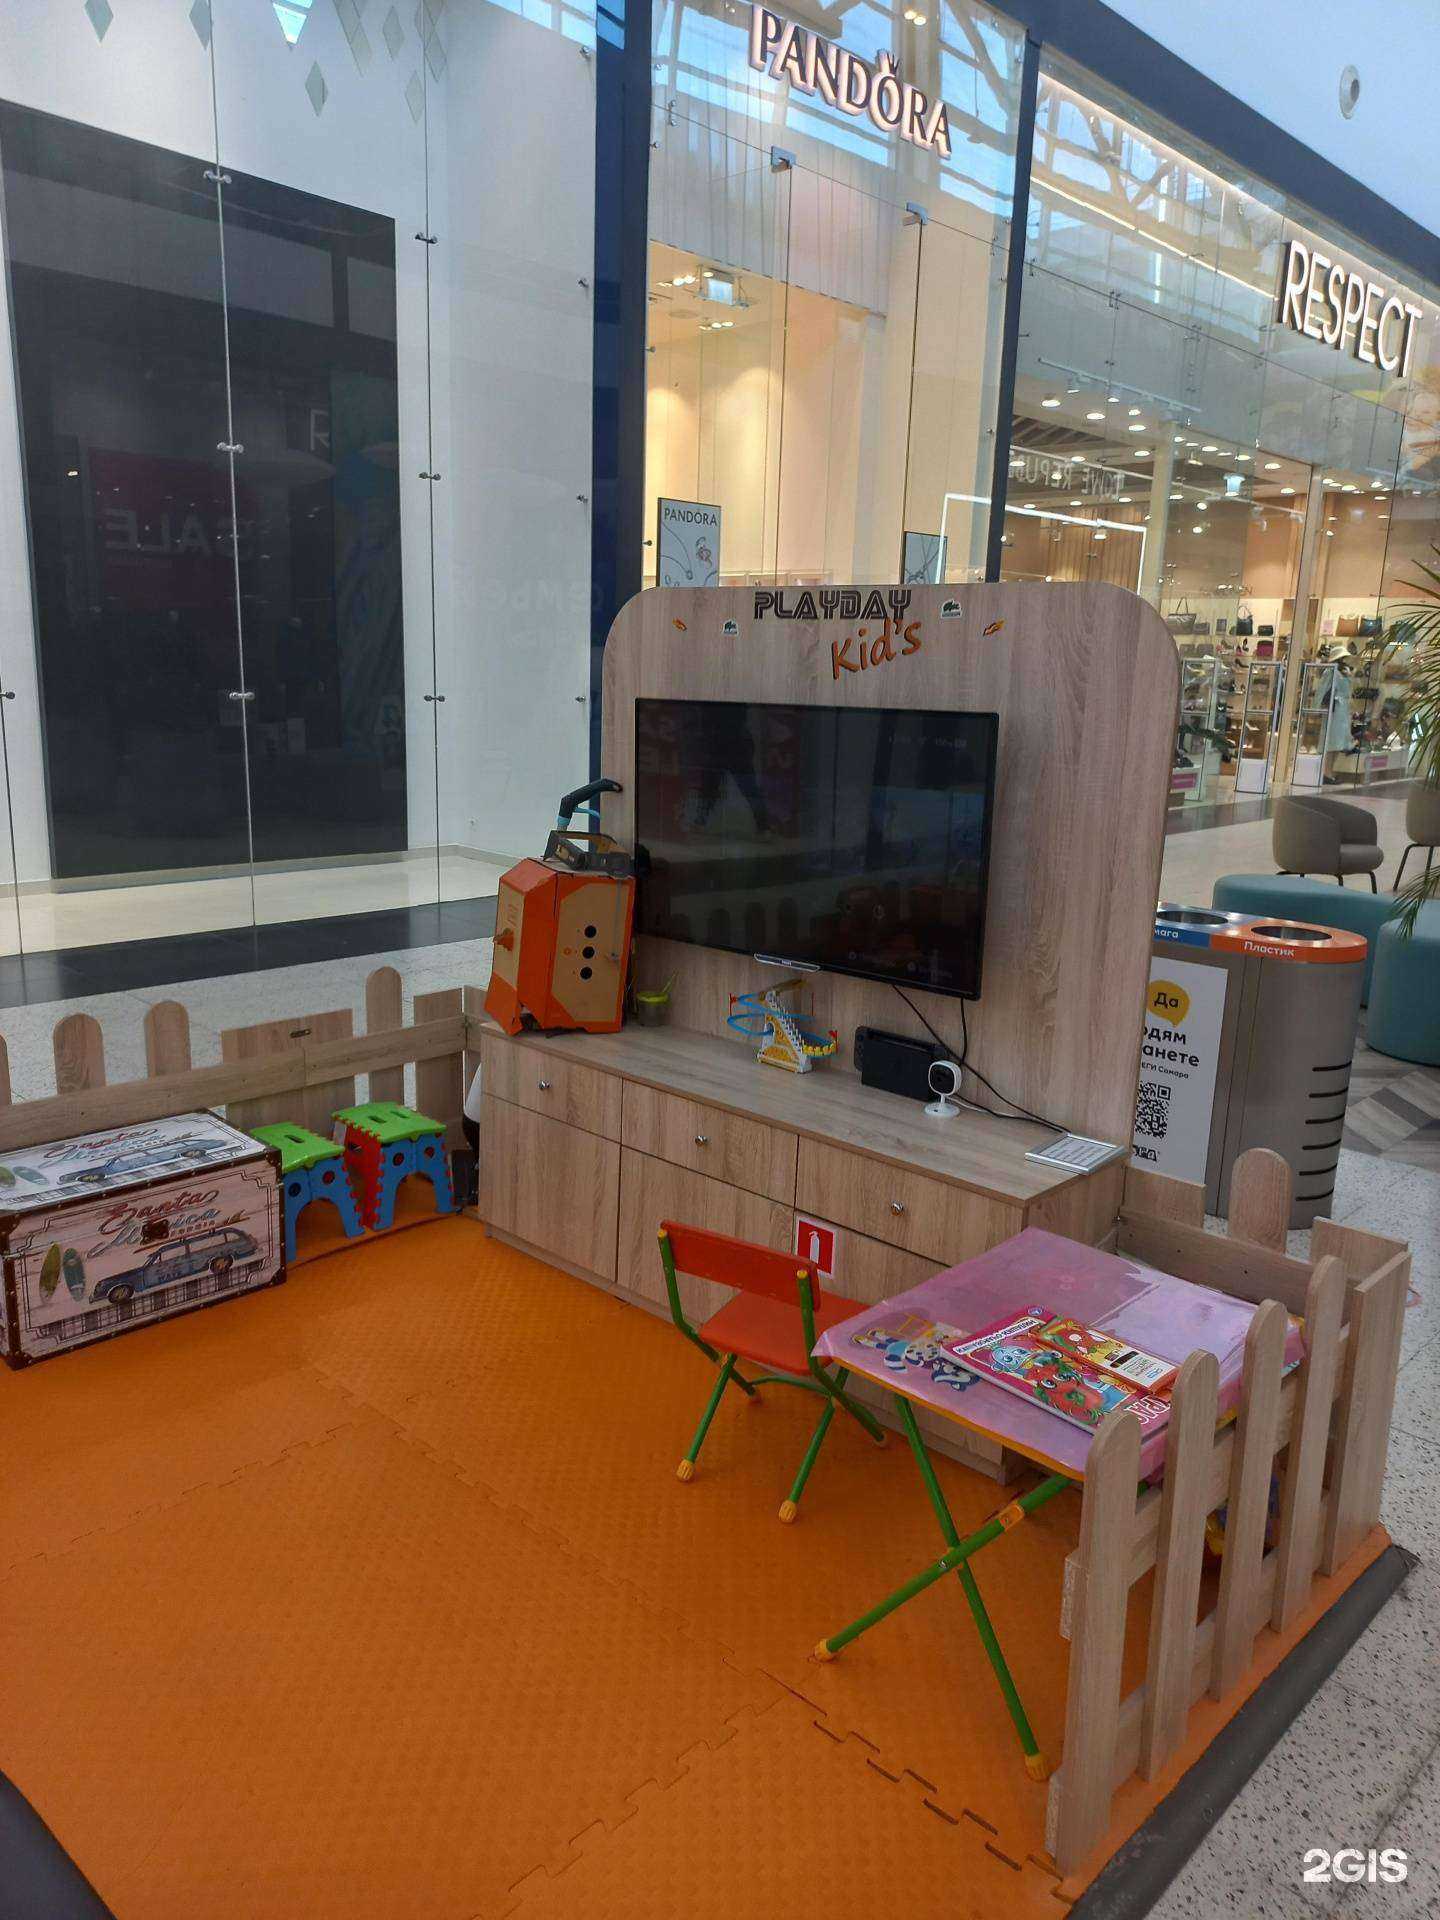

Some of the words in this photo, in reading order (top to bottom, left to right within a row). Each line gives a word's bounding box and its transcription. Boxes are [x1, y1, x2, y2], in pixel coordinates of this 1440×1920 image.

[751, 4, 952, 160] PANDORA
[1280, 239, 1423, 378] RESPECT
[664, 508, 718, 526] PANDORA
[754, 589, 912, 620] PLAYDAY
[832, 616, 922, 680] Kid's
[1244, 940, 1295, 957] Пластик
[1154, 992, 1179, 1009] Да
[99, 1188, 221, 1236] Santa
